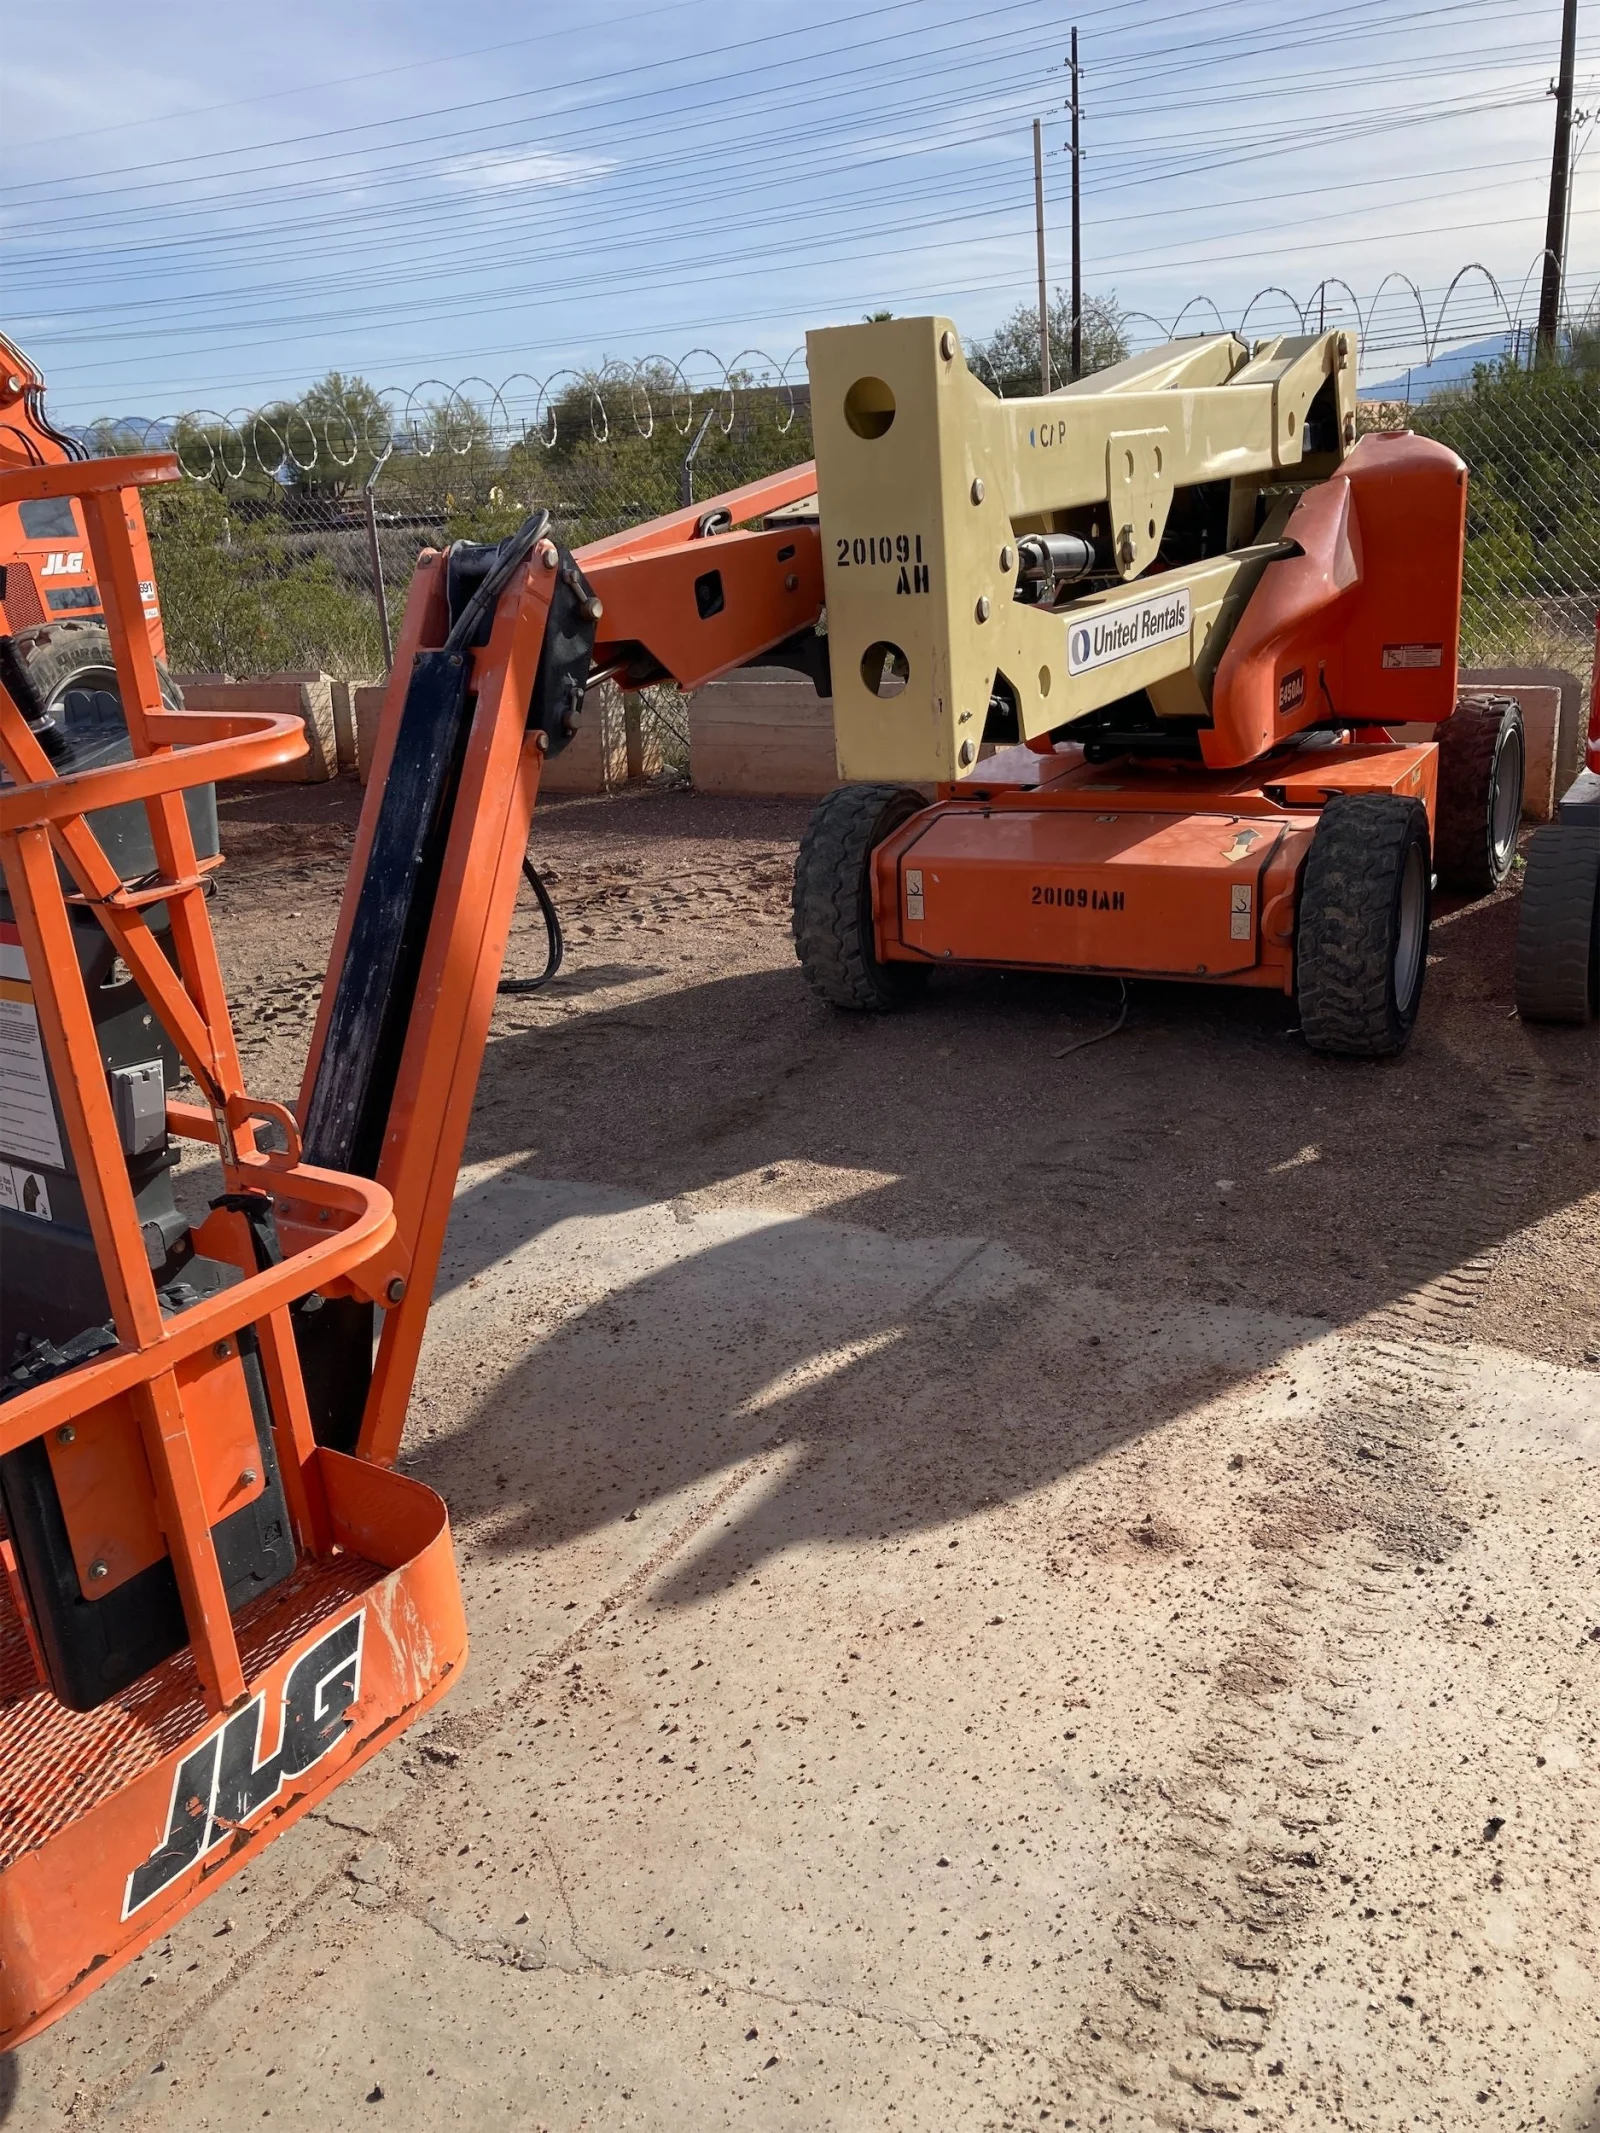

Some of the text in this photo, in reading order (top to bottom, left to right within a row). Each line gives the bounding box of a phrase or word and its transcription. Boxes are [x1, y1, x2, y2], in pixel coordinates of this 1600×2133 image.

[42, 552, 83, 576] JLG
[837, 535, 921, 566] 201091
[897, 565, 929, 595] AH
[1094, 600, 1185, 656] United Rentals
[119, 1606, 367, 1923] JLG
